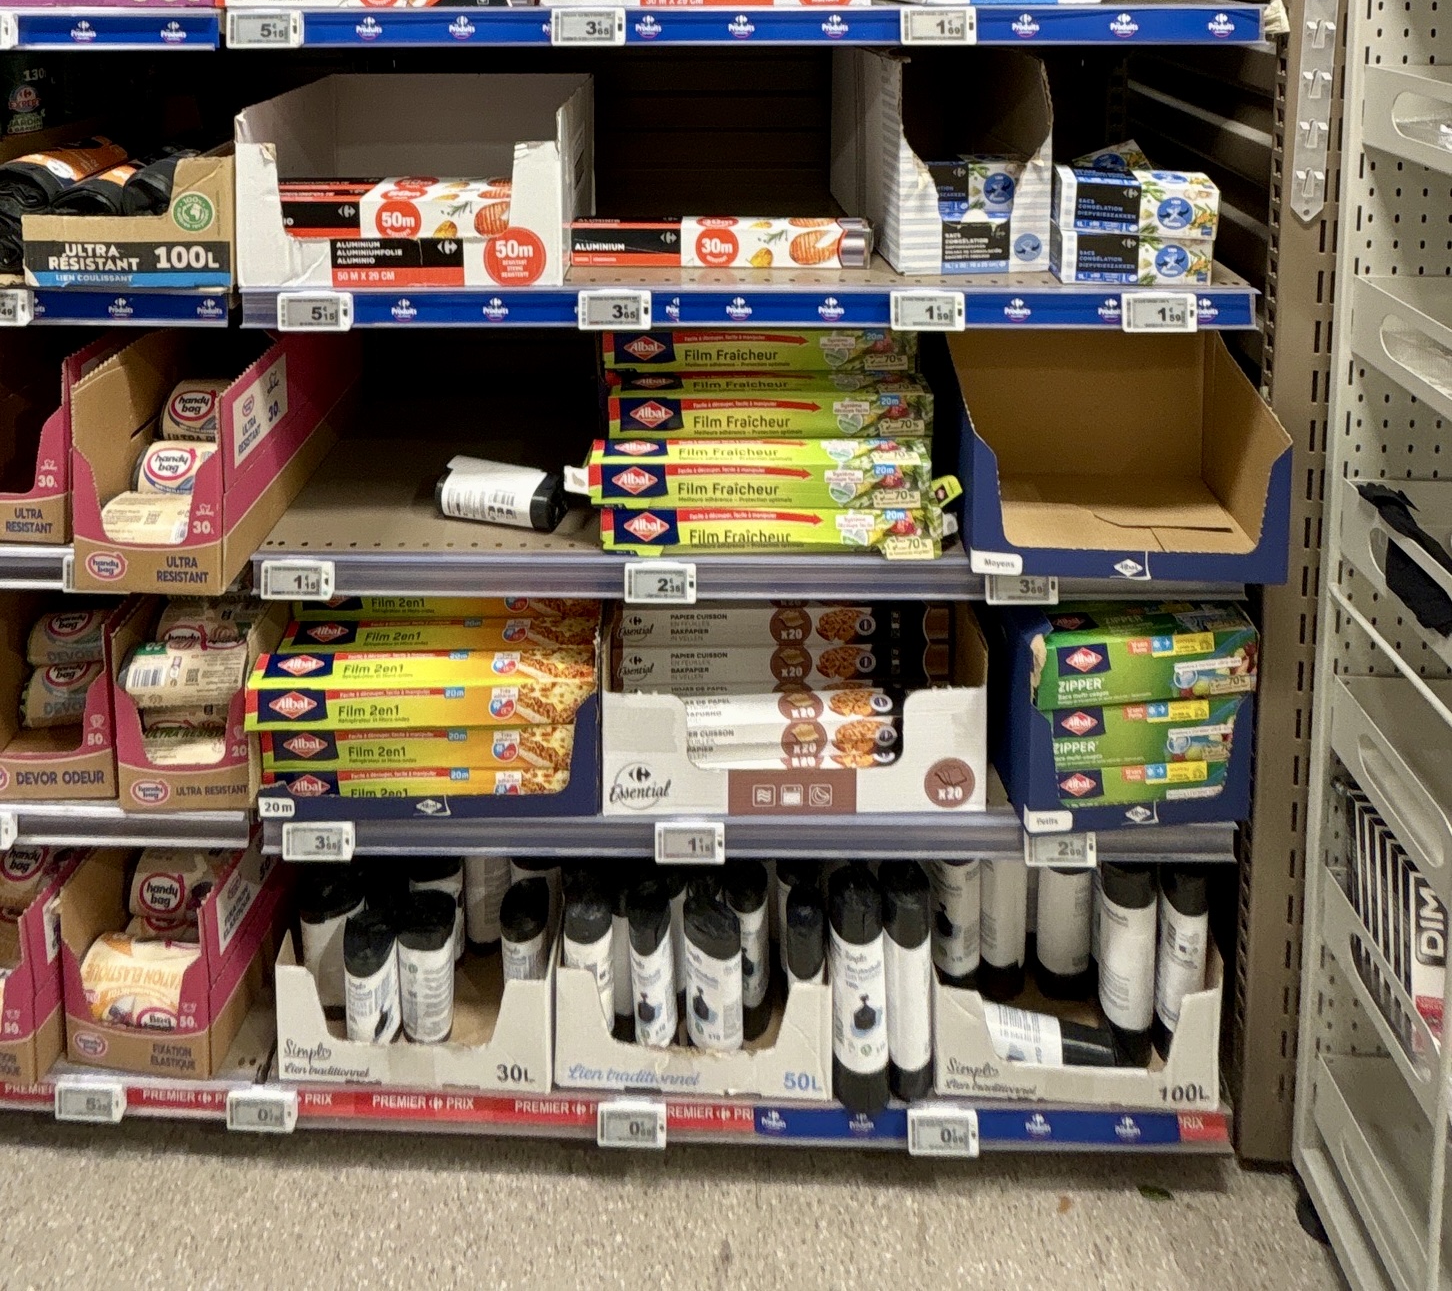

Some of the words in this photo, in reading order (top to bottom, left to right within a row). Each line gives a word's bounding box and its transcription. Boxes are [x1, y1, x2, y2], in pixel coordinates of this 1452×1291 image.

[381, 211, 415, 228] 50m
[65, 243, 120, 257] ULTRA
[495, 240, 534, 258] 50m
[701, 236, 733, 254] 30m
[154, 245, 220, 269] 100L
[336, 249, 403, 257] ALUMINIUMFOLIE
[48, 254, 140, 271] RÉSISTANT
[337, 257, 376, 265] ALUMINIO
[55, 273, 75, 282] LIEN
[77, 274, 133, 283] COULISSANT
[630, 342, 658, 352] Albal
[684, 349, 712, 360] Film
[716, 349, 778, 360] Fraîcheur
[178, 394, 210, 407] handy
[881, 397, 899, 406] 20m
[181, 404, 202, 415] bag
[637, 407, 666, 418] Albal
[693, 416, 721, 428] Film
[726, 415, 791, 428] Fraîcheur
[900, 419, 913, 429] 70
[154, 453, 189, 466] handy
[157, 463, 180, 475] bag
[875, 466, 895, 475] 20m
[618, 473, 650, 485] Albal
[678, 483, 708, 496] Film
[712, 482, 780, 496] Fraîcheur
[895, 490, 908, 500] 70
[14, 507, 43, 520] ULTRA
[5, 521, 53, 534] RESISTANT
[630, 519, 661, 531] Albal
[166, 556, 198, 569] ULTRA
[984, 557, 1016, 569] Moyens
[156, 571, 209, 583] RESISTANT
[1058, 677, 1102, 693] ZIPPER
[278, 698, 308, 710] Albal
[338, 705, 366, 717] Film
[369, 705, 400, 717] 2en1
[348, 747, 374, 758] Film
[377, 746, 407, 757] 2en1
[16, 770, 59, 786] DEVOR
[61, 770, 105, 785] ODEUR
[176, 785, 203, 797] ULTRA
[204, 783, 248, 796] RESISTANT
[609, 776, 672, 806] Essential
[1036, 815, 1059, 826] Petits
[146, 883, 179, 897] handy
[150, 894, 172, 908] bag
[1418, 885, 1445, 957] DIM
[152, 1043, 192, 1059] FIXATION
[495, 1063, 537, 1084] 30L
[783, 1070, 823, 1092] 50L
[1158, 1082, 1210, 1103] 100L
[372, 1093, 427, 1109] PREMIER
[446, 1096, 475, 1110] PRIX
